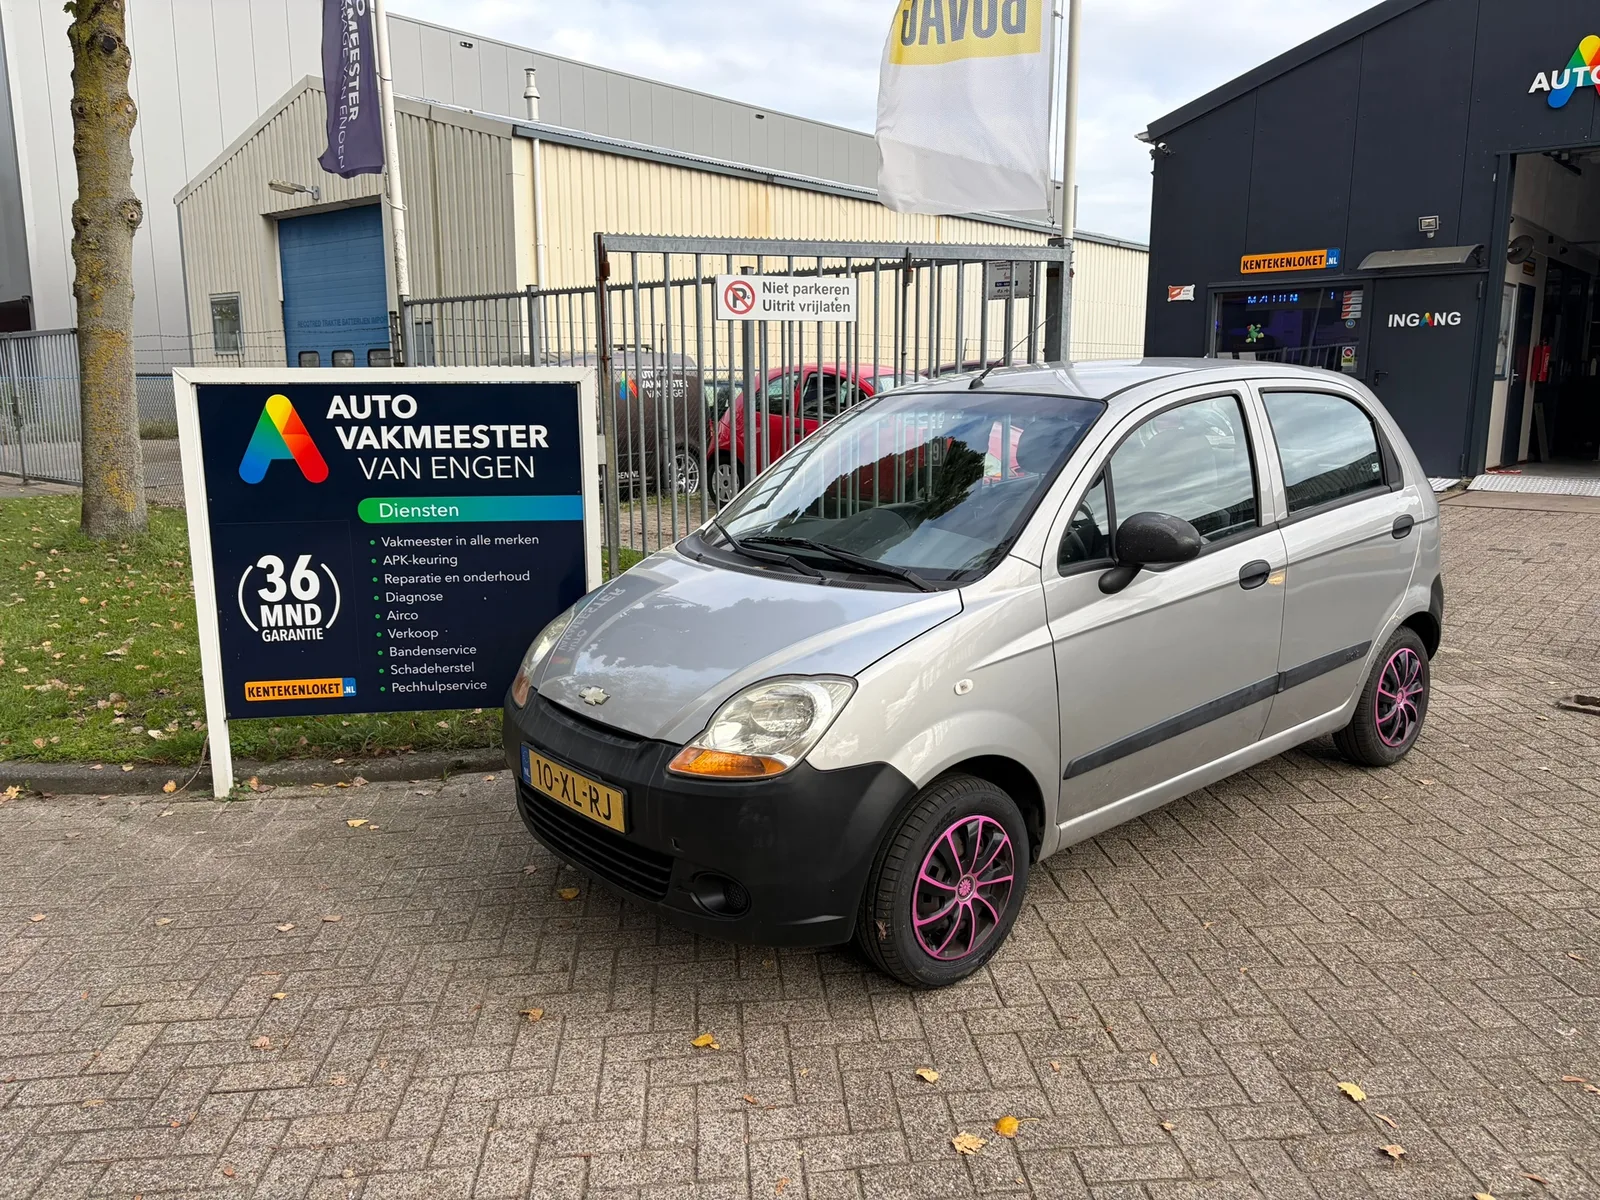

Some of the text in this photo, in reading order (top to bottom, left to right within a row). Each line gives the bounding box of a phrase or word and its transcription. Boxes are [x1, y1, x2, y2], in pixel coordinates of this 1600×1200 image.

[763, 282, 849, 297] Niet parkeren
[763, 300, 849, 314] Uitrit vrijlaten
[1387, 311, 1462, 328] INGANG
[326, 394, 417, 419] AUTO
[335, 425, 549, 449] VAKMEESTER
[358, 456, 534, 479] VAN ENGEN
[380, 503, 458, 517] Diensten
[381, 534, 538, 547] Vakmeester in alle merken
[383, 555, 457, 567] APK-keuring
[257, 555, 321, 601] 36
[385, 573, 441, 586] Reparatie
[464, 571, 529, 582] onderhoud
[386, 592, 443, 604] Diagnose
[260, 603, 322, 627] MND
[387, 611, 418, 620] Airco
[261, 627, 323, 642] GARANTIE
[388, 628, 438, 640] Verkoop
[390, 645, 476, 656] Bandenservice
[391, 662, 474, 674] Schadeherstel
[392, 680, 487, 693] Pechhulpservice
[536, 759, 612, 821] 10-XL-RJ
